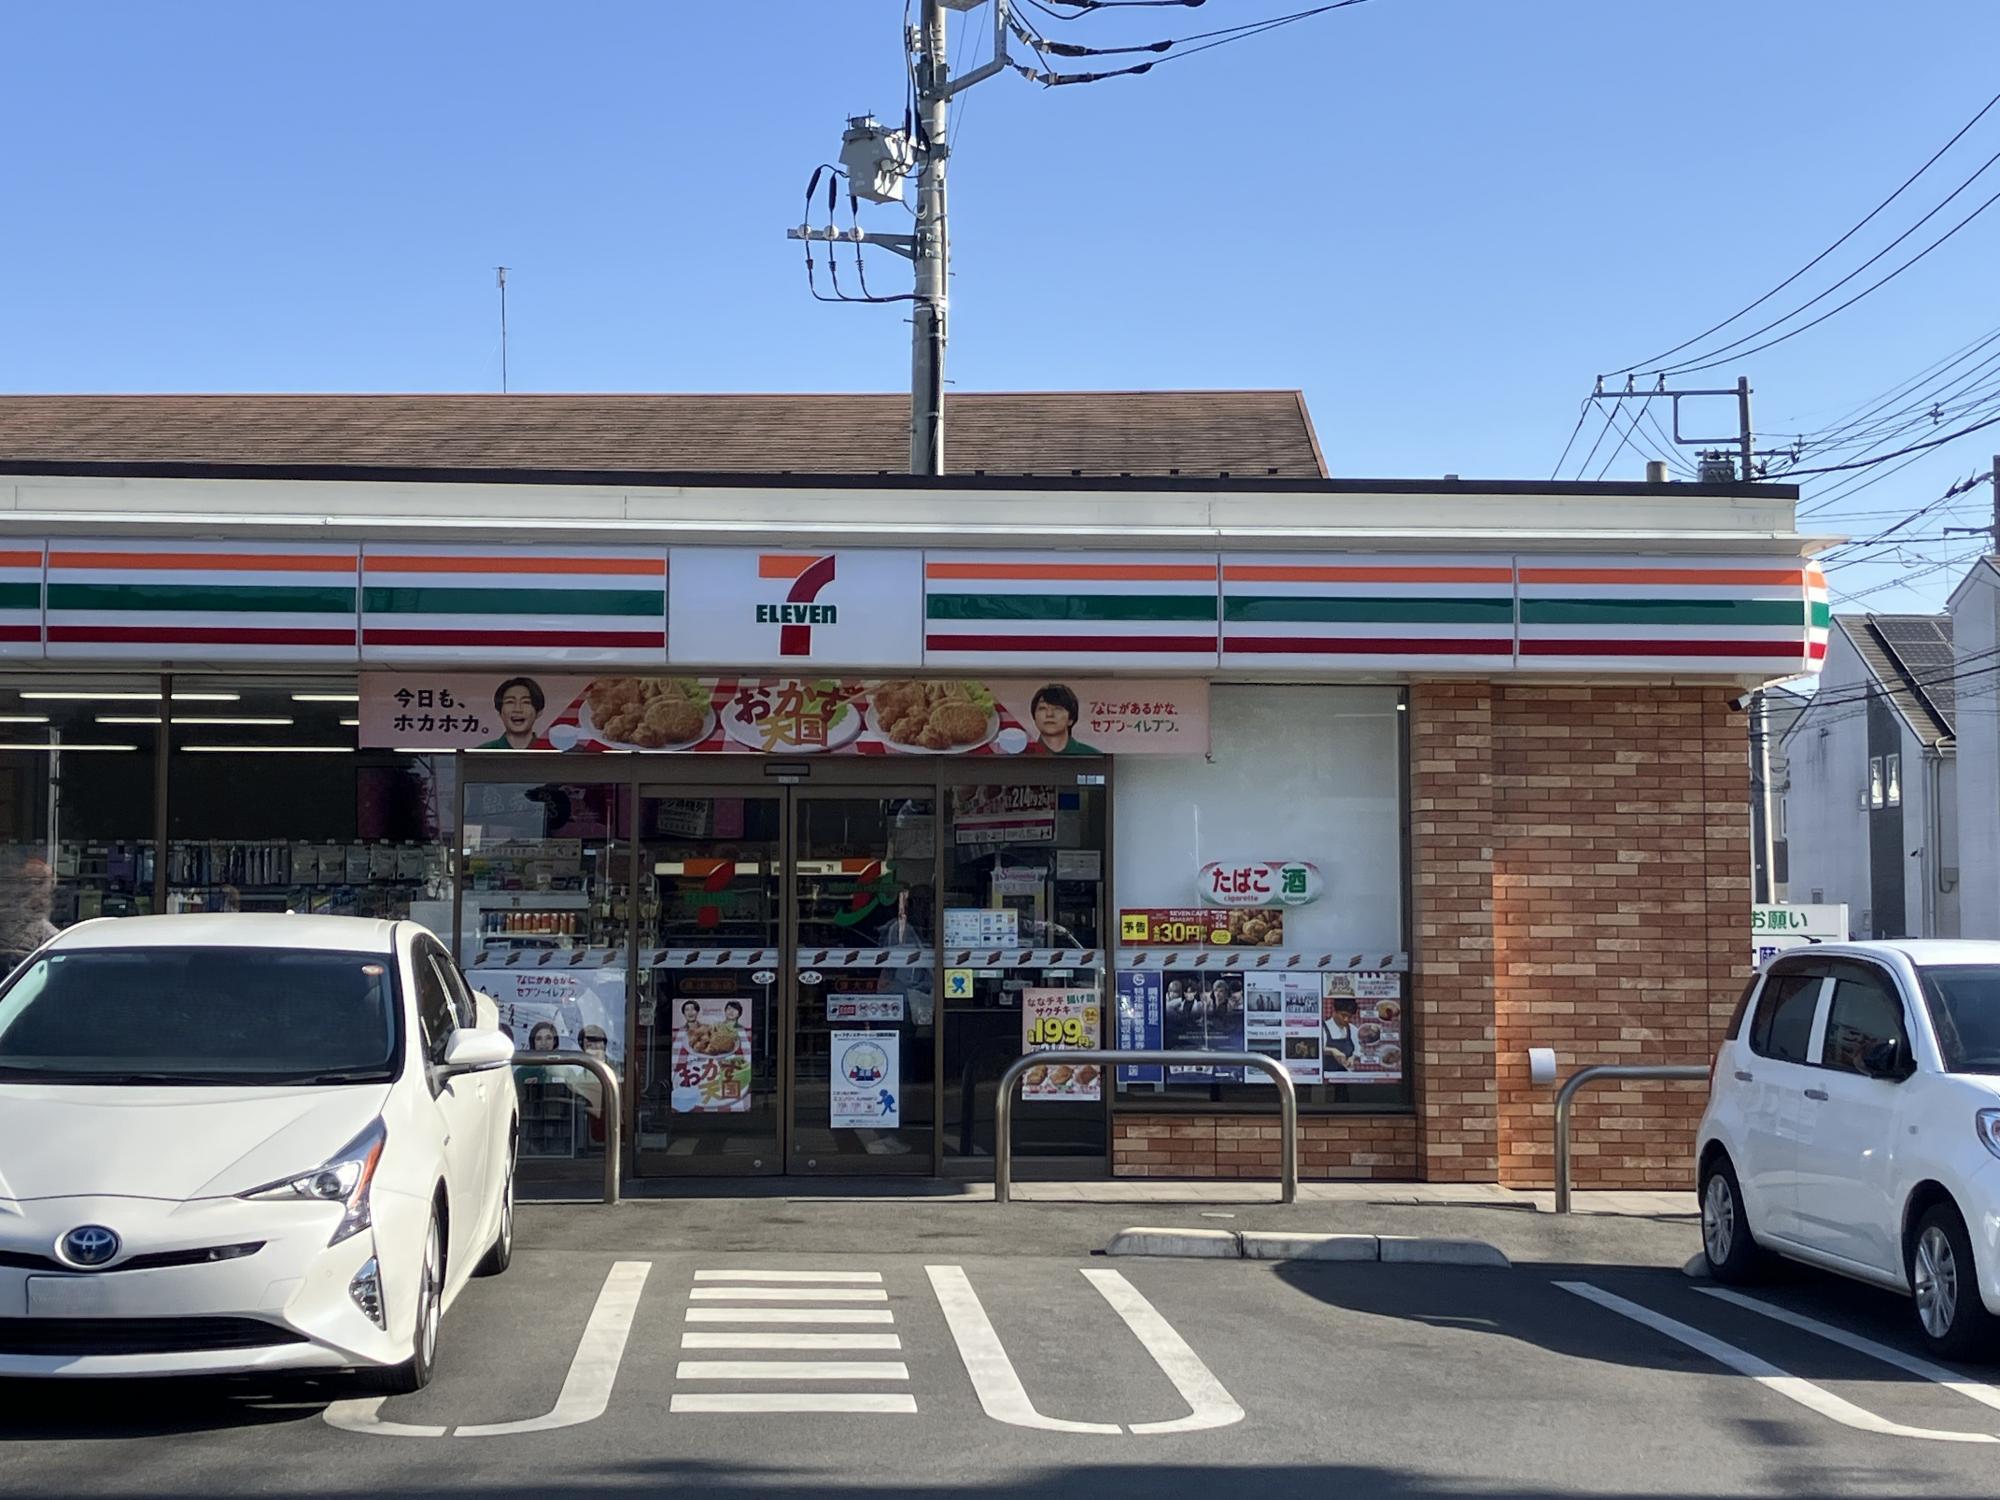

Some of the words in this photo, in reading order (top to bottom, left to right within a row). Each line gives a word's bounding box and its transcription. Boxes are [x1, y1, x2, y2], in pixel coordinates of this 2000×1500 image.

[758, 554, 836, 656] 7
[394, 688, 466, 709] 今日も、
[735, 681, 865, 725] おかず
[394, 714, 489, 735] ホカホカ。
[756, 710, 829, 753] 天国
[1212, 867, 1270, 893] たばこ
[1281, 868, 1307, 893] 酒
[1123, 921, 1146, 934] 予告
[1751, 910, 1808, 930] お願い
